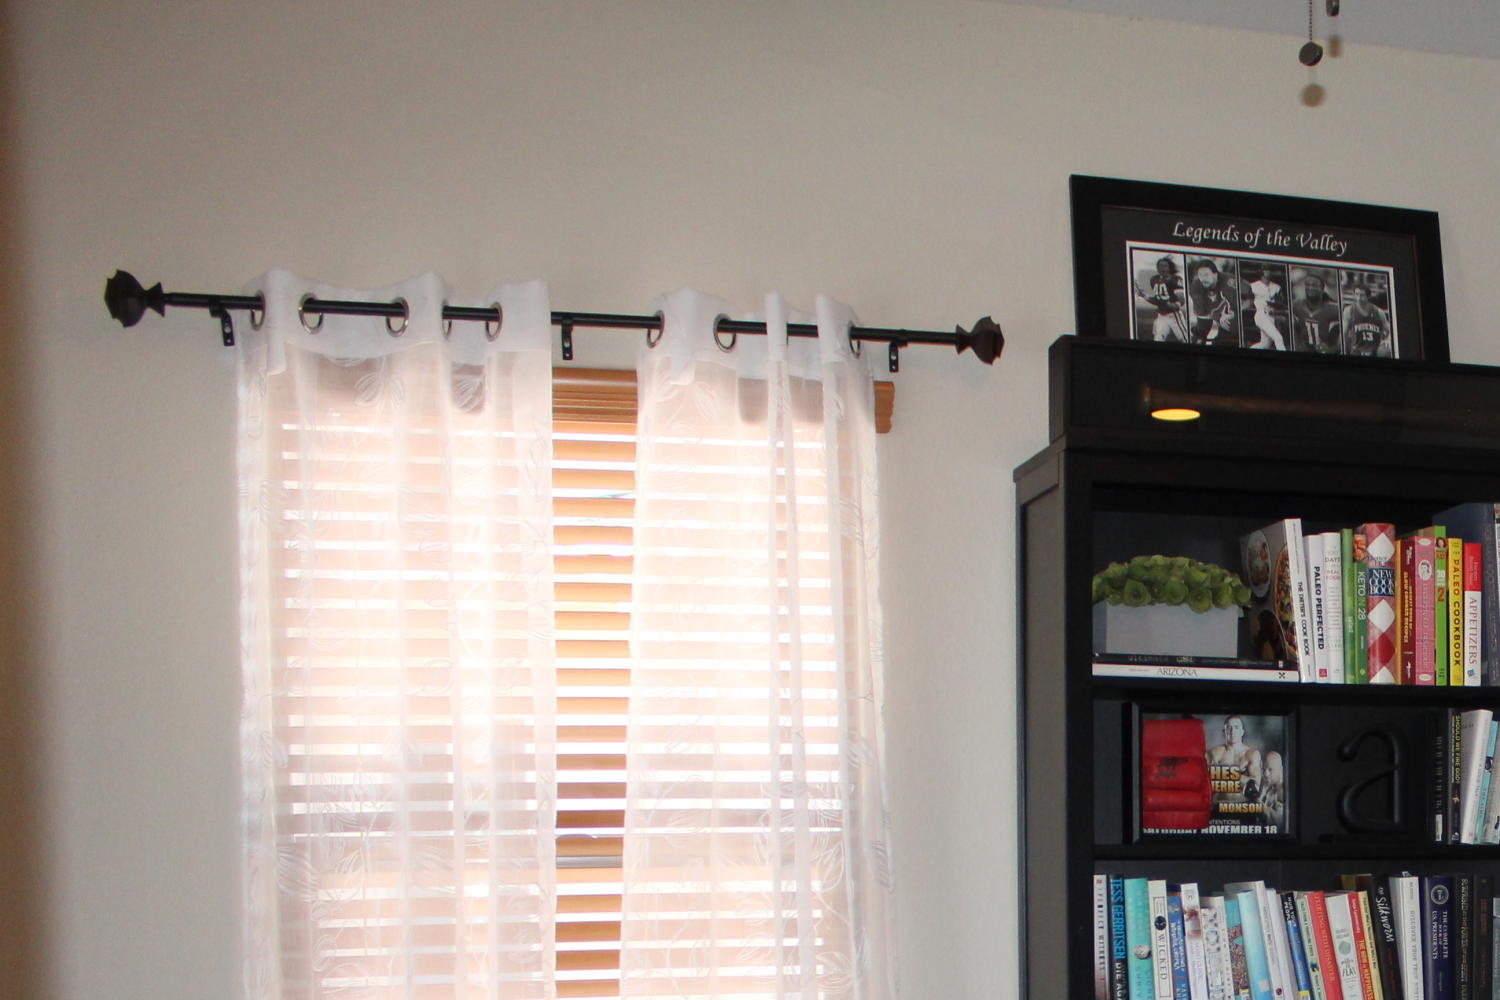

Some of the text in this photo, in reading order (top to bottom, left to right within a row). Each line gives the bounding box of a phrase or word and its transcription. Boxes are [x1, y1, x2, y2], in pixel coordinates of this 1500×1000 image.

[1173, 222, 1346, 257] Legends of the Valley
[1362, 332, 1372, 341] 13
[1315, 598, 1324, 649] PERFECTED
[1358, 608, 1366, 620] 28
[1452, 559, 1461, 666] PALEO COOKBOOK
[1300, 620, 1308, 636] COOK
[1469, 597, 1477, 664] APPETIZERS
[1157, 668, 1197, 677] ARIZONA
[1219, 803, 1262, 813] MONSON
[1111, 878, 1124, 903] TESS
[1113, 905, 1126, 960] GERRITSEN
[1374, 896, 1394, 943] Silkworm
[1115, 962, 1125, 981] DIE
[1158, 934, 1168, 980] WICKED
